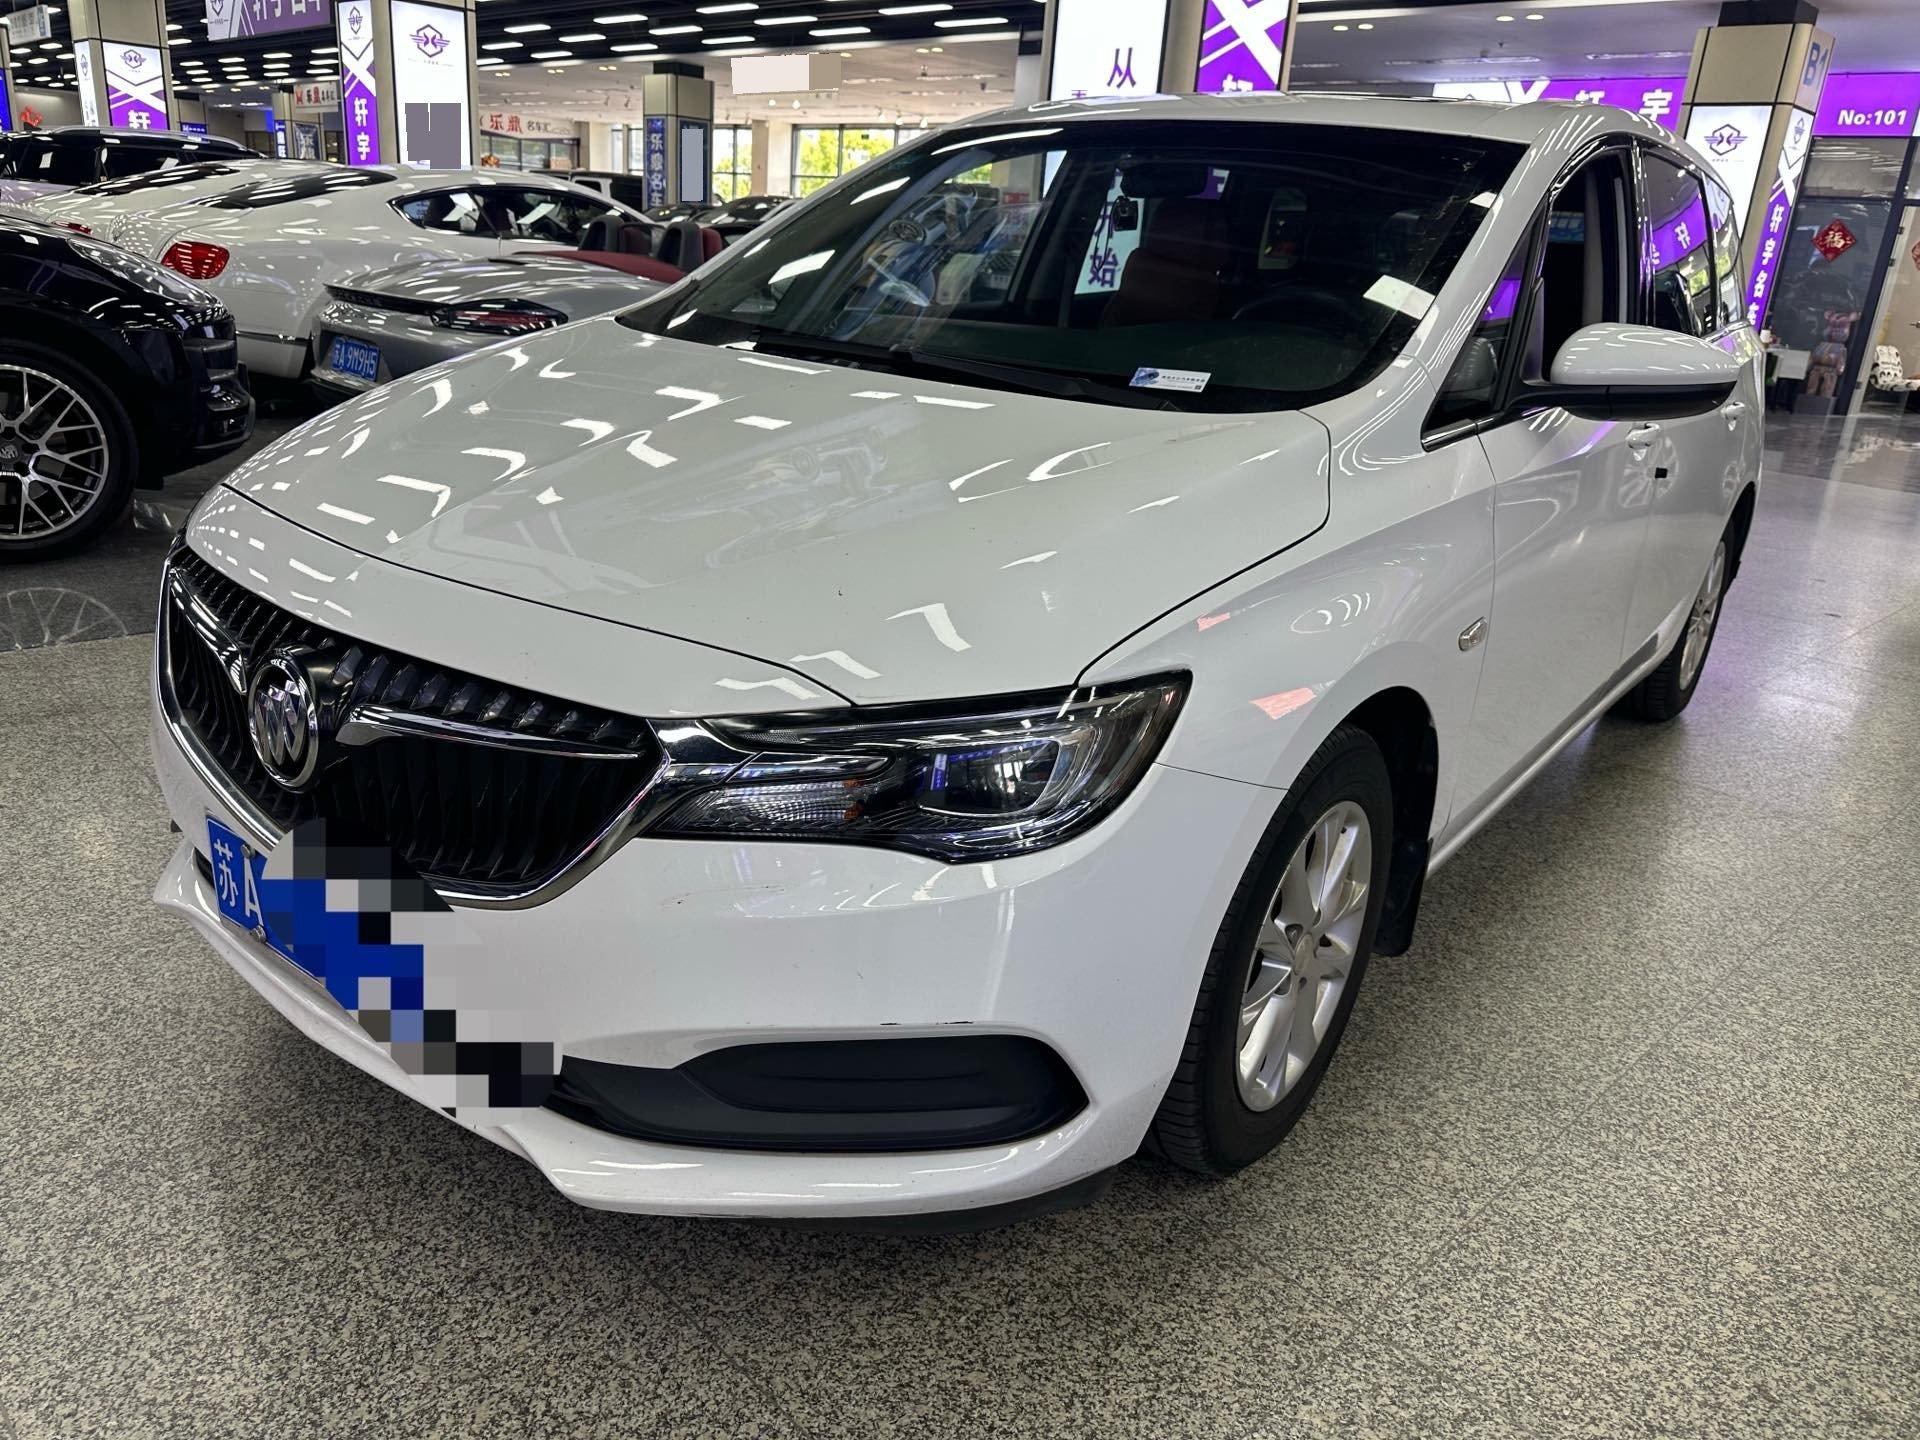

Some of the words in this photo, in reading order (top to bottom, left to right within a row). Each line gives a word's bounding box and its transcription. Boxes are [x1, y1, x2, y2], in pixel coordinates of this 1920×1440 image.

[1106, 47, 1137, 89] 从
[1803, 42, 1829, 90] B1
[354, 97, 370, 161] 轩宇
[1837, 109, 1908, 126] No:101
